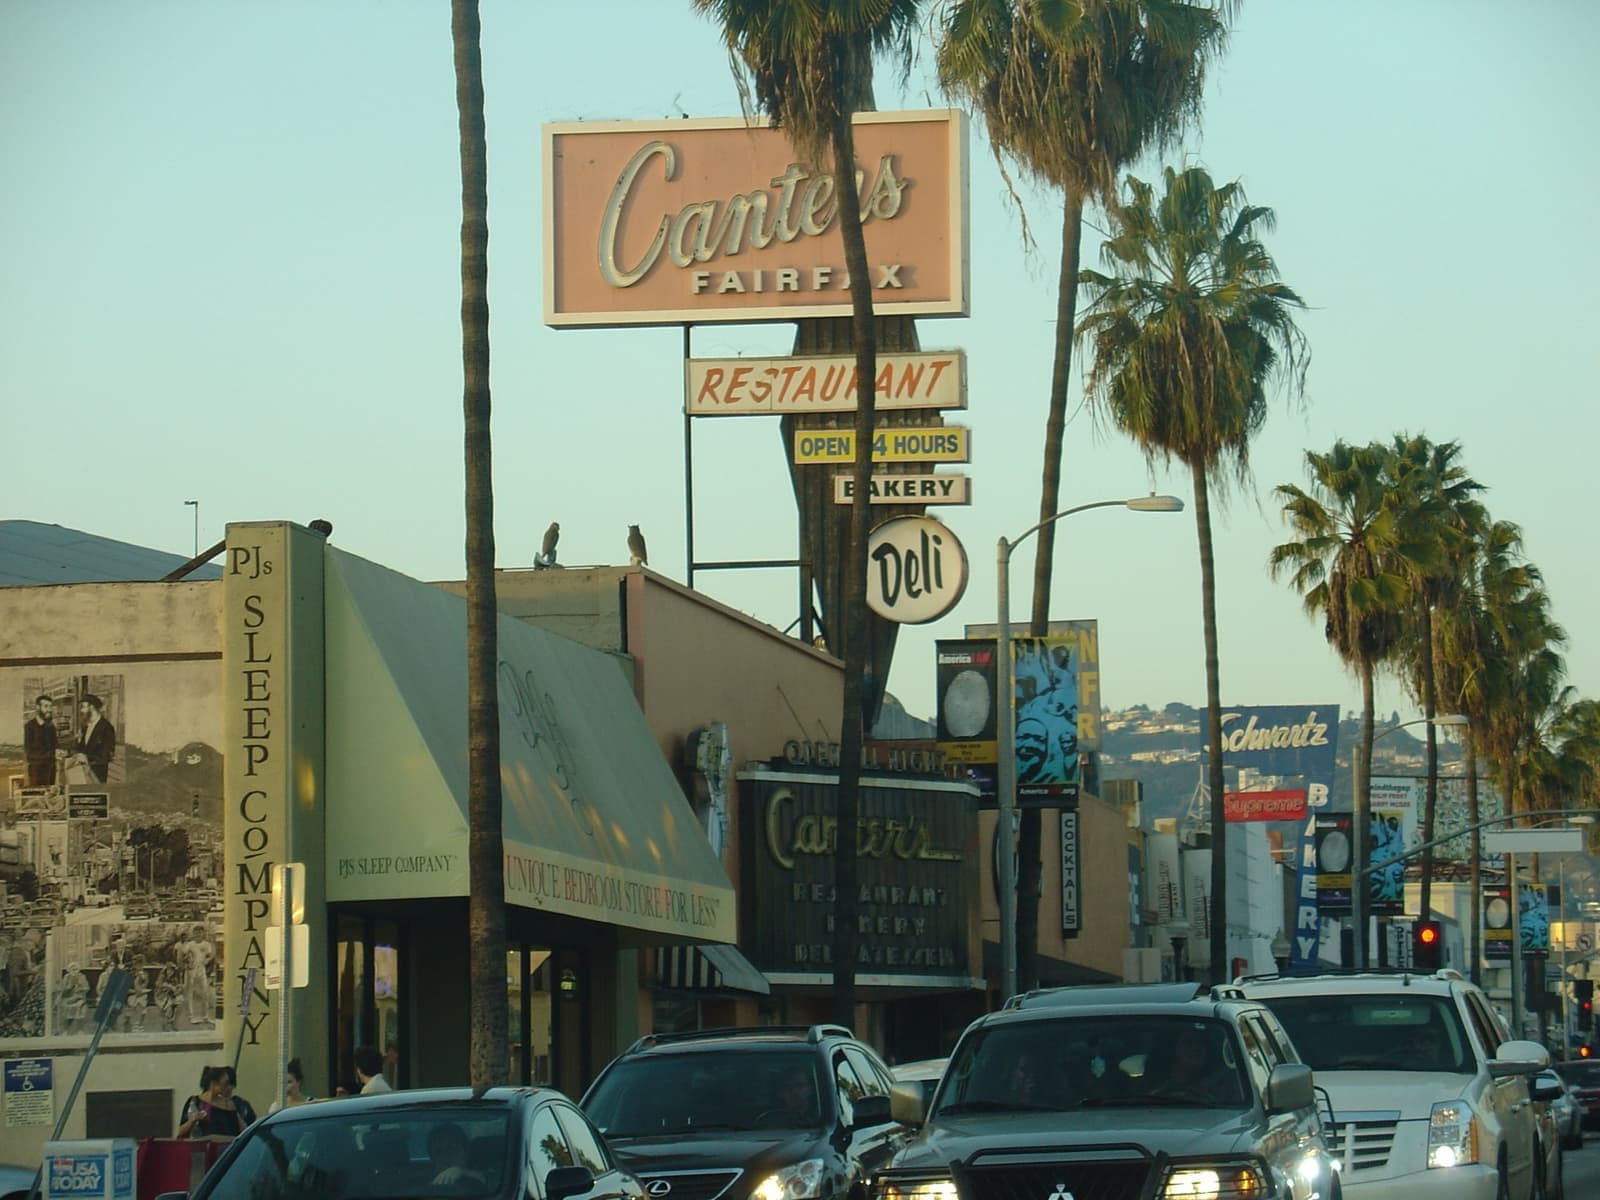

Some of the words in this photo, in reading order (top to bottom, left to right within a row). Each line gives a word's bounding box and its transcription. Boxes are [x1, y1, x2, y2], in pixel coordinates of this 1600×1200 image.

[692, 264, 904, 294] FAIRFX
[800, 437, 850, 456] OPEN
[894, 435, 959, 454] HOURS
[230, 546, 272, 580] PJs
[872, 528, 943, 607] Deli
[242, 595, 273, 777] SLEEP
[1203, 710, 1329, 753] Schwartz
[862, 747, 881, 770] LL
[1224, 796, 1303, 815] Supreme
[357, 856, 392, 874] SLEEP
[394, 854, 452, 873] COMPANY
[1064, 819, 1075, 924] COCKTAILS
[506, 855, 561, 899] UNIQUE
[563, 867, 623, 912] BEDROOM
[624, 880, 664, 919] STORE
[665, 889, 689, 923] FOR
[793, 882, 948, 907] RESAURANT
[53, 1175, 102, 1190] TODAY
[70, 1162, 99, 1176] USA
